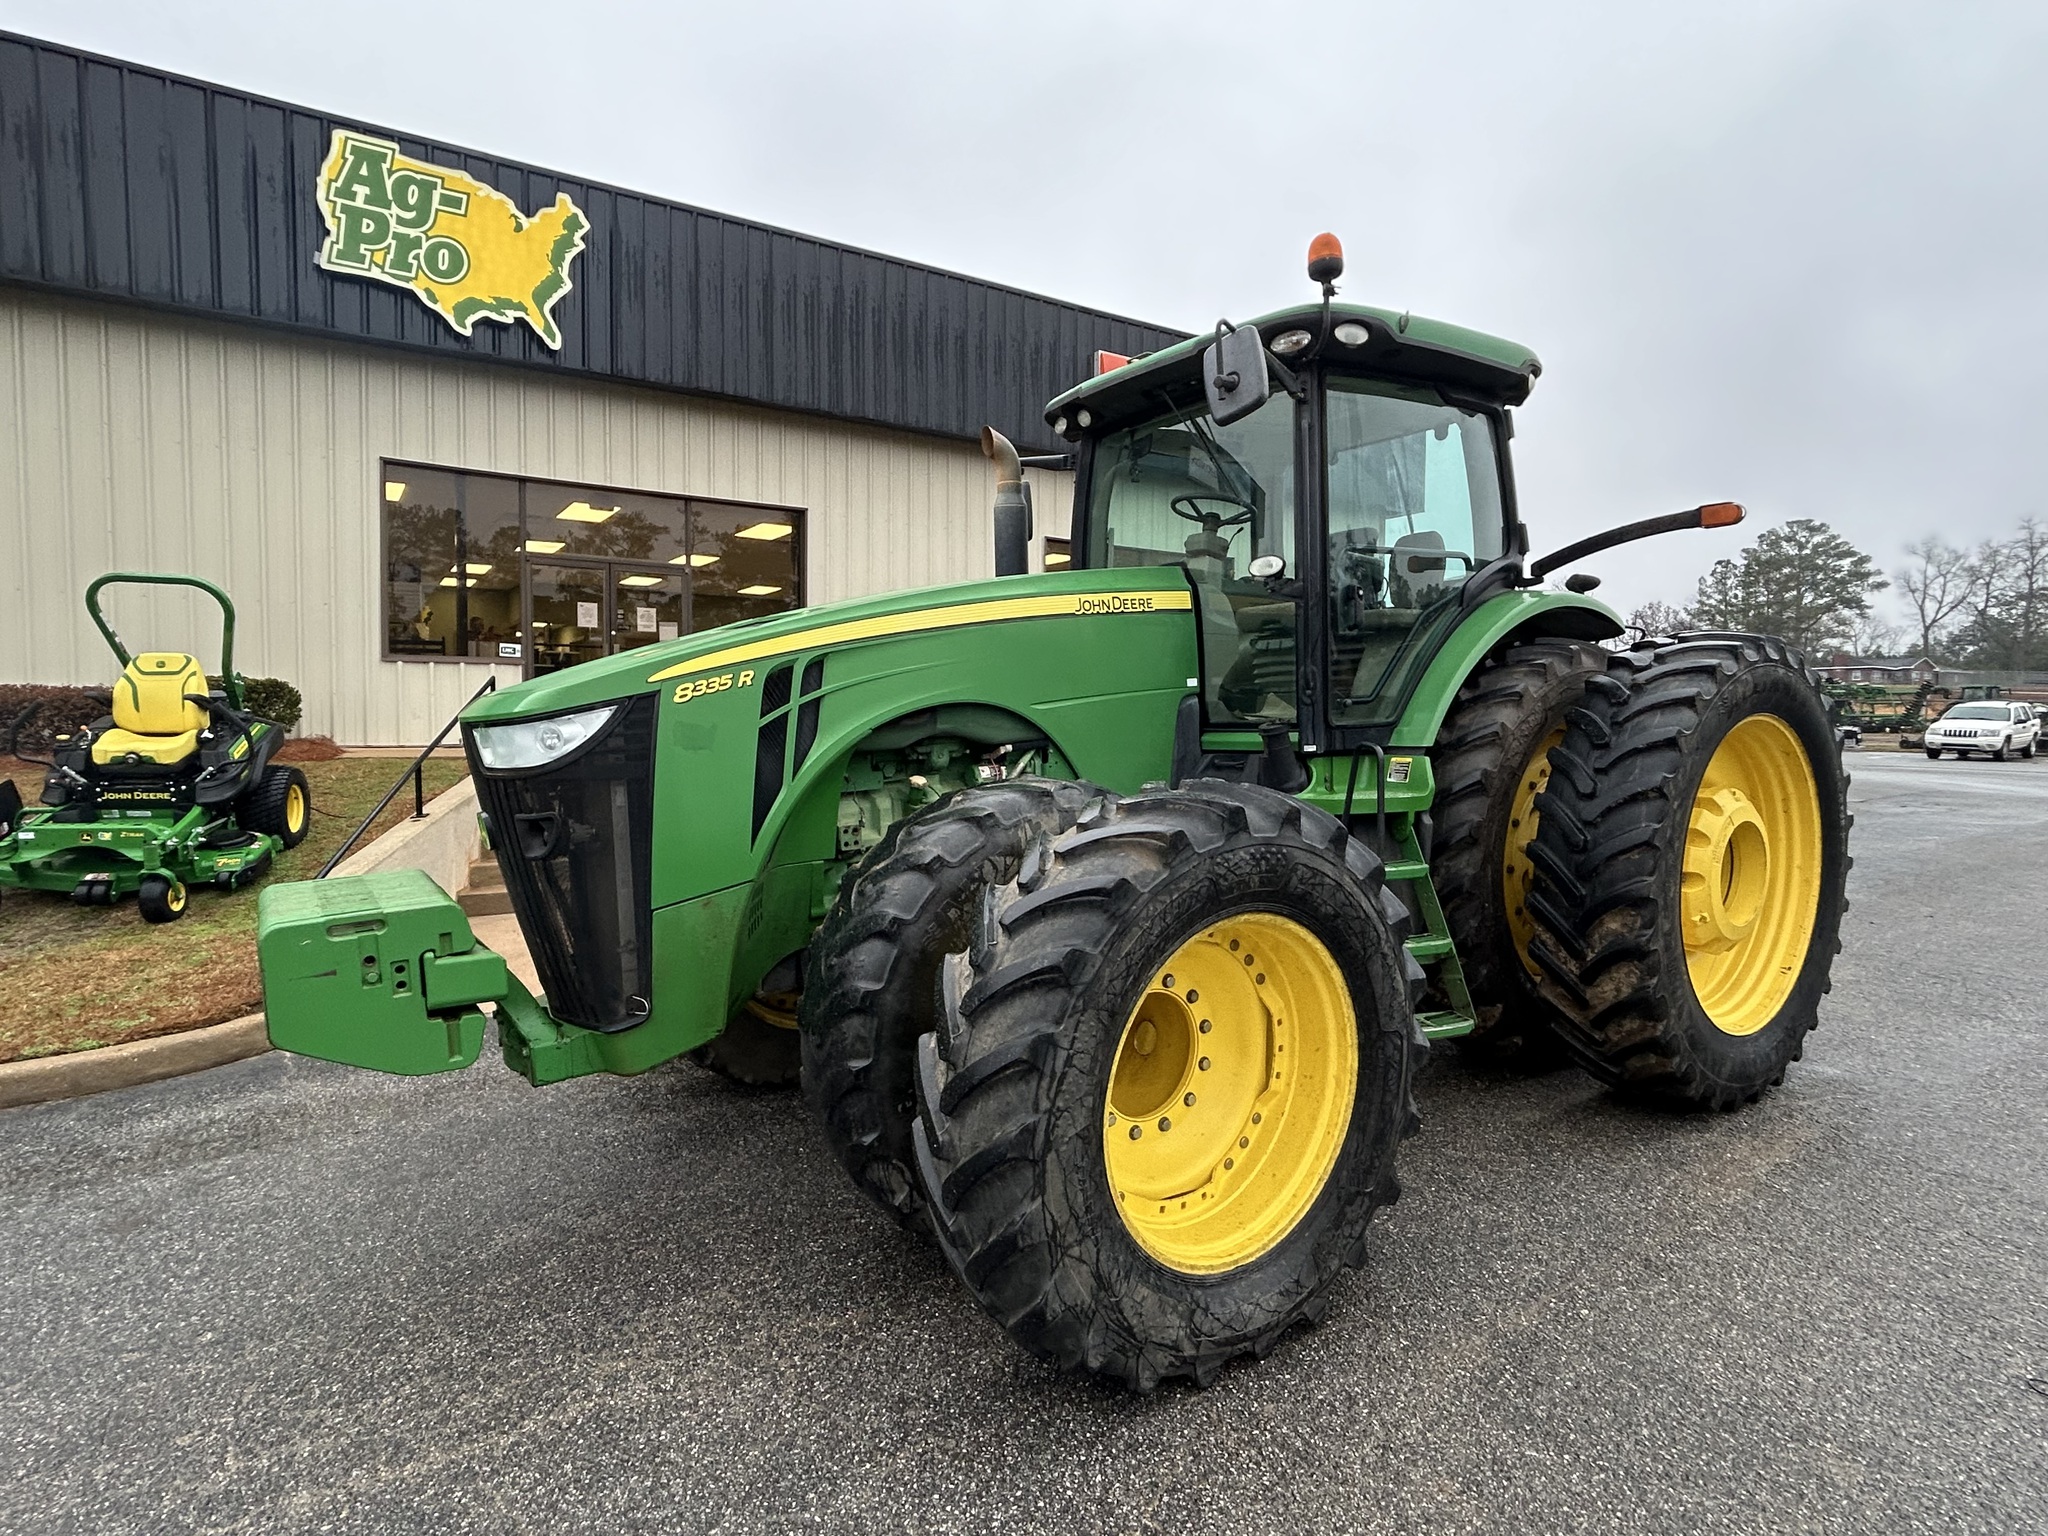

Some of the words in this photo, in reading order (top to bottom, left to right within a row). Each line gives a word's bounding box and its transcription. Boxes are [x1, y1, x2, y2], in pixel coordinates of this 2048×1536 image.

[330, 141, 468, 231] Ag-
[331, 202, 469, 283] Pro
[1075, 597, 1111, 613] JOHN
[1112, 596, 1154, 611] DEERE
[673, 673, 733, 703] 8335
[738, 669, 755, 687] R
[101, 792, 132, 800] JOHN
[133, 791, 171, 800] DEERE
